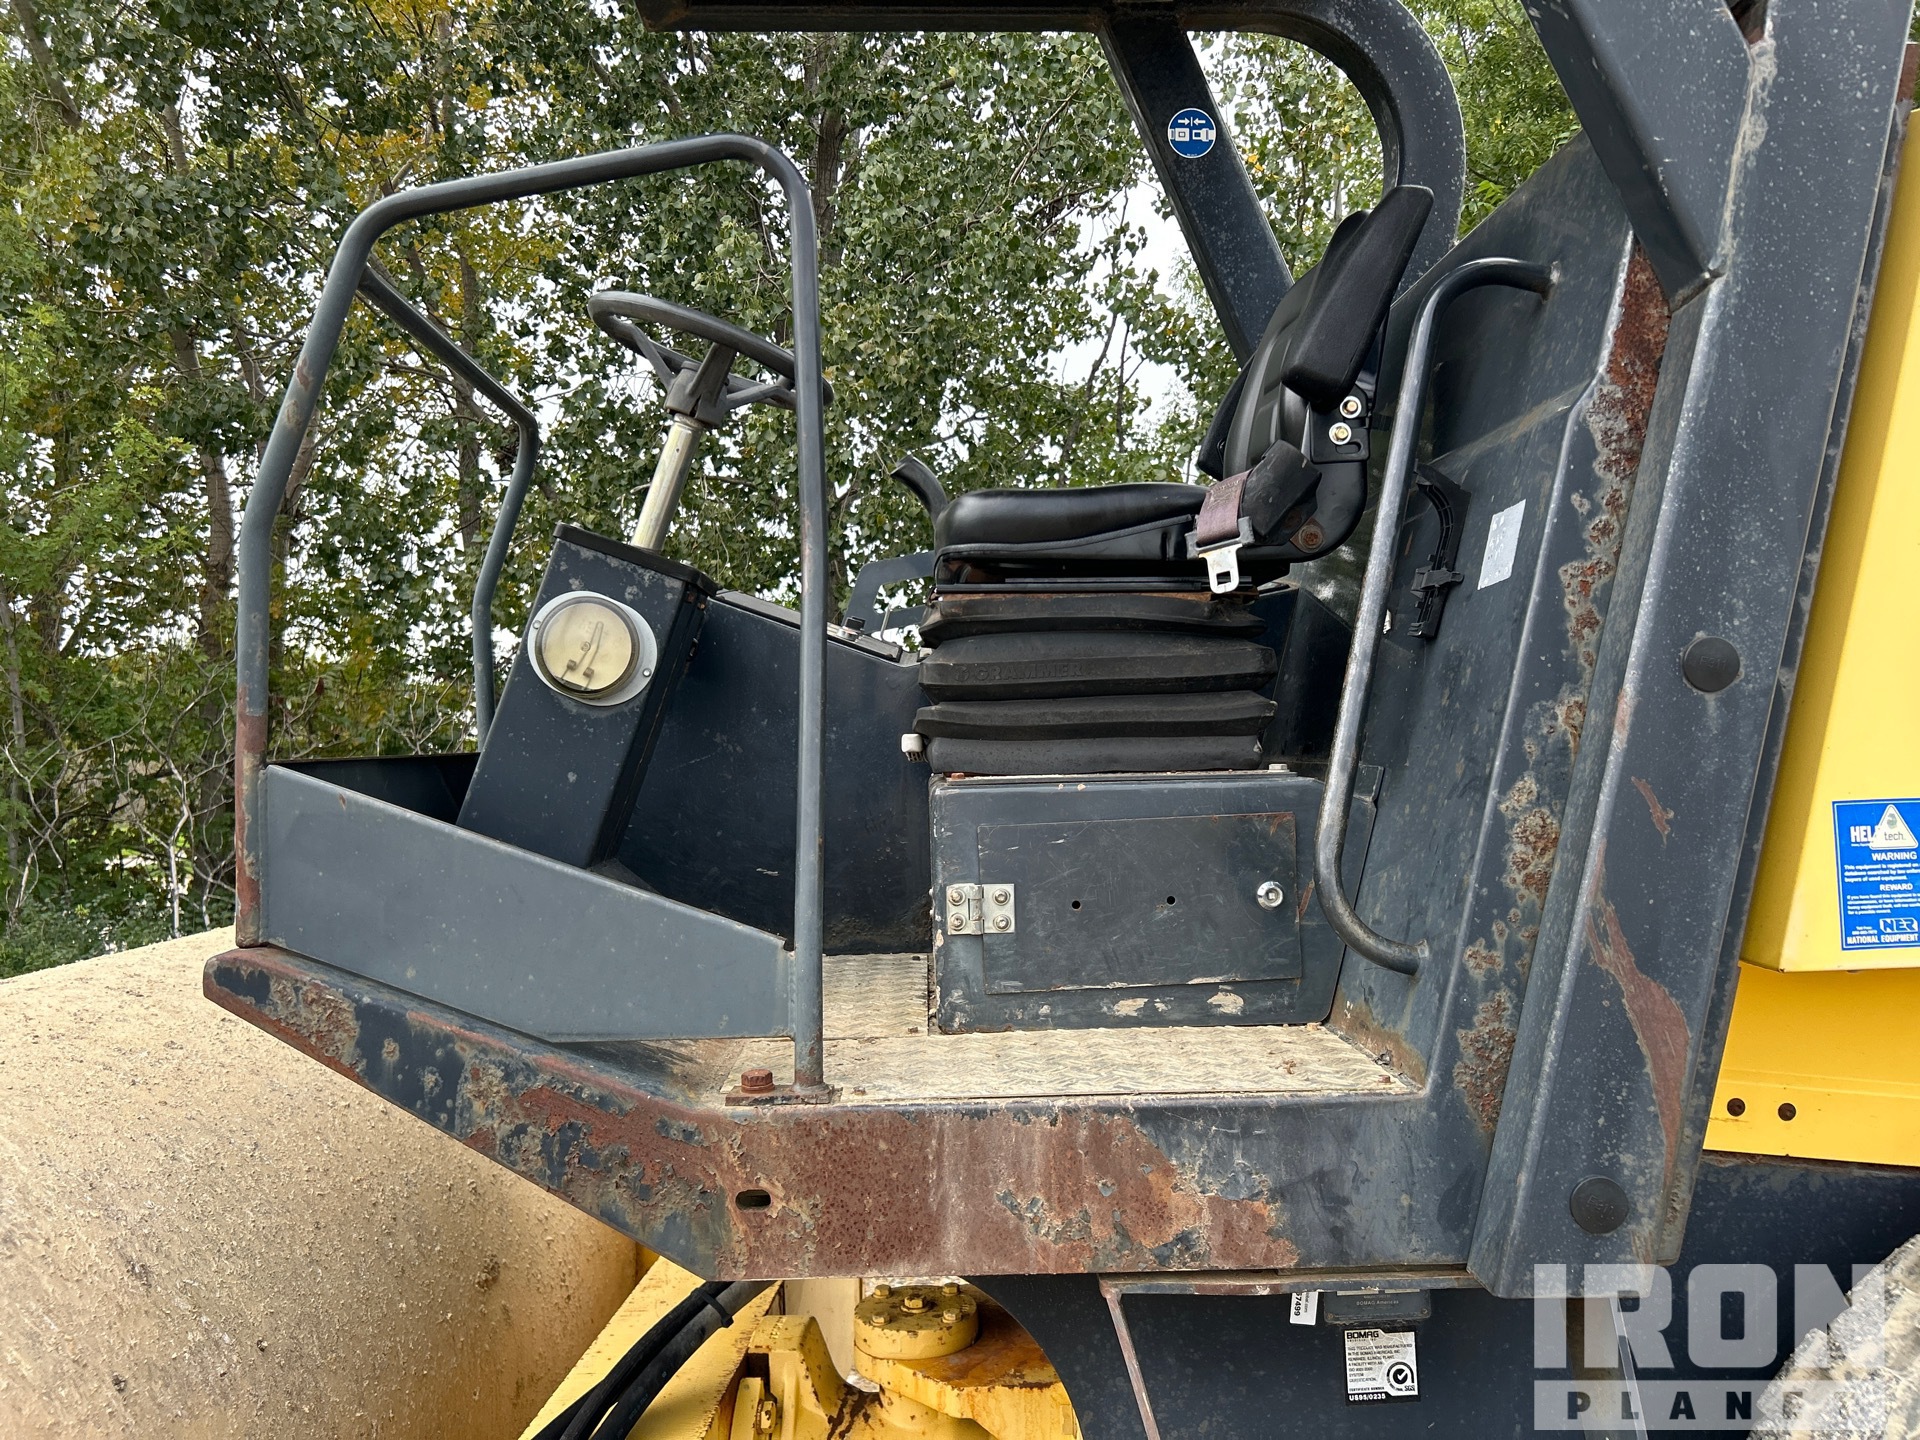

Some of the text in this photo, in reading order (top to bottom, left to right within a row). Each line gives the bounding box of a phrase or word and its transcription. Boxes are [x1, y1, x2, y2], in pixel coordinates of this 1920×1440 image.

[1871, 851, 1917, 861] WARNING
[1880, 883, 1912, 891] REWARD
[1881, 918, 1917, 932] NER
[1847, 933, 1918, 944] NATIONAL EQUIPMENT
[1346, 1331, 1379, 1339] BOMAG
